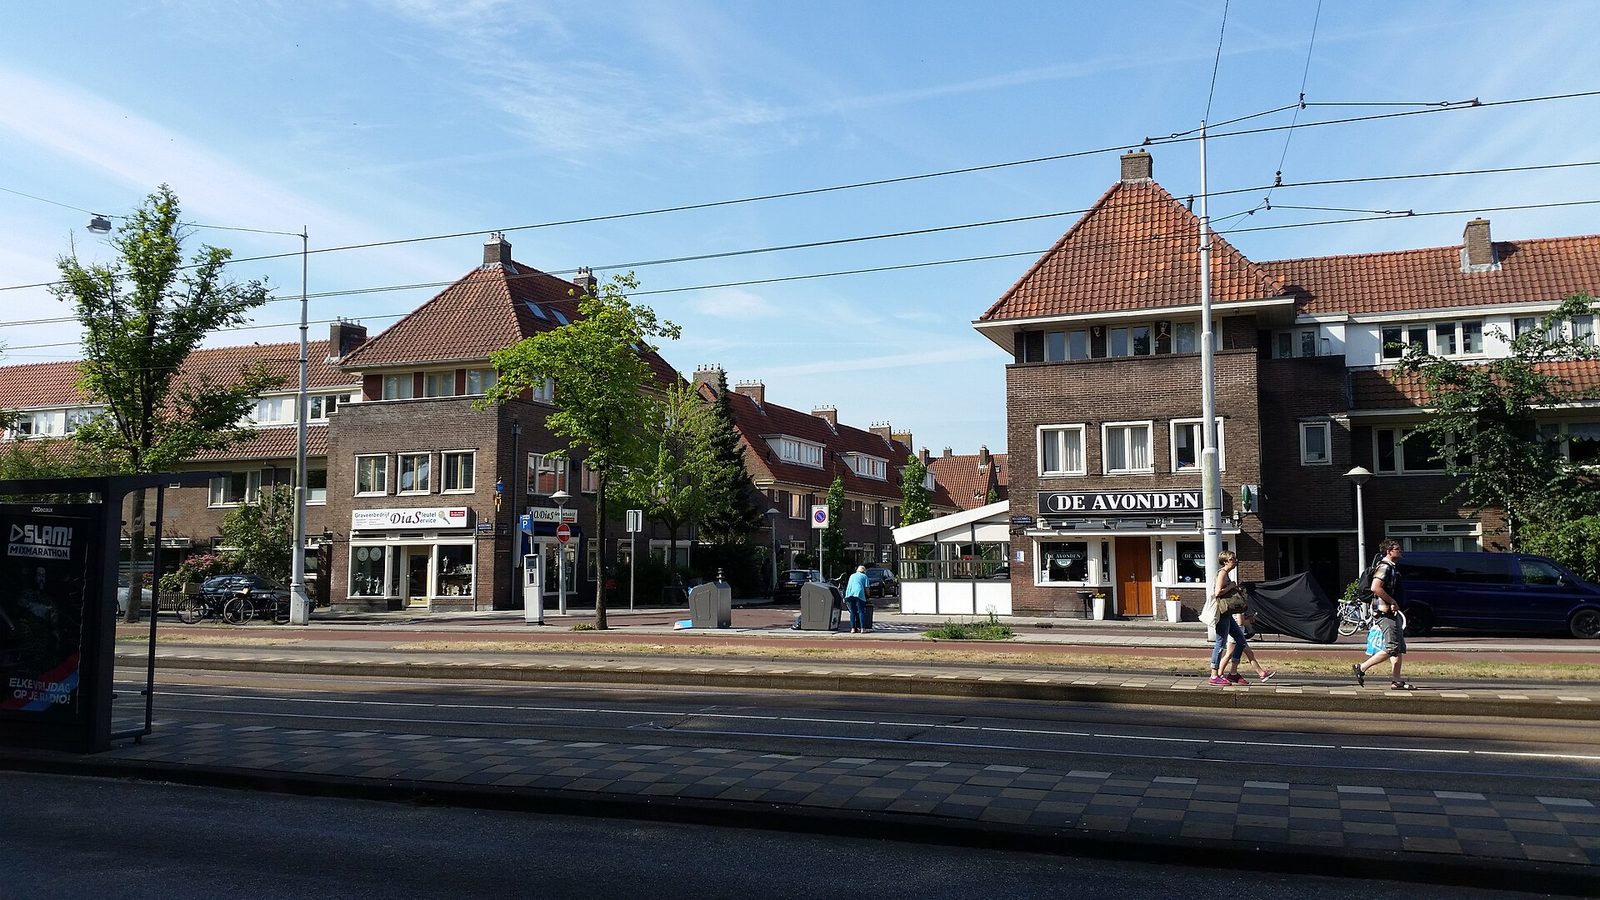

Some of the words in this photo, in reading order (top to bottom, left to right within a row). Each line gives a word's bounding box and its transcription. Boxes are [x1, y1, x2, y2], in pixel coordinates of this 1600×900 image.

[1056, 494, 1086, 511] DE
[1092, 492, 1200, 510] AVONDEN
[24, 524, 73, 546] SLAM!
[9, 545, 68, 558] MIXMARATHON
[13, 689, 28, 699] OP
[28, 691, 39, 700] JE
[39, 692, 71, 704] RADIO!
